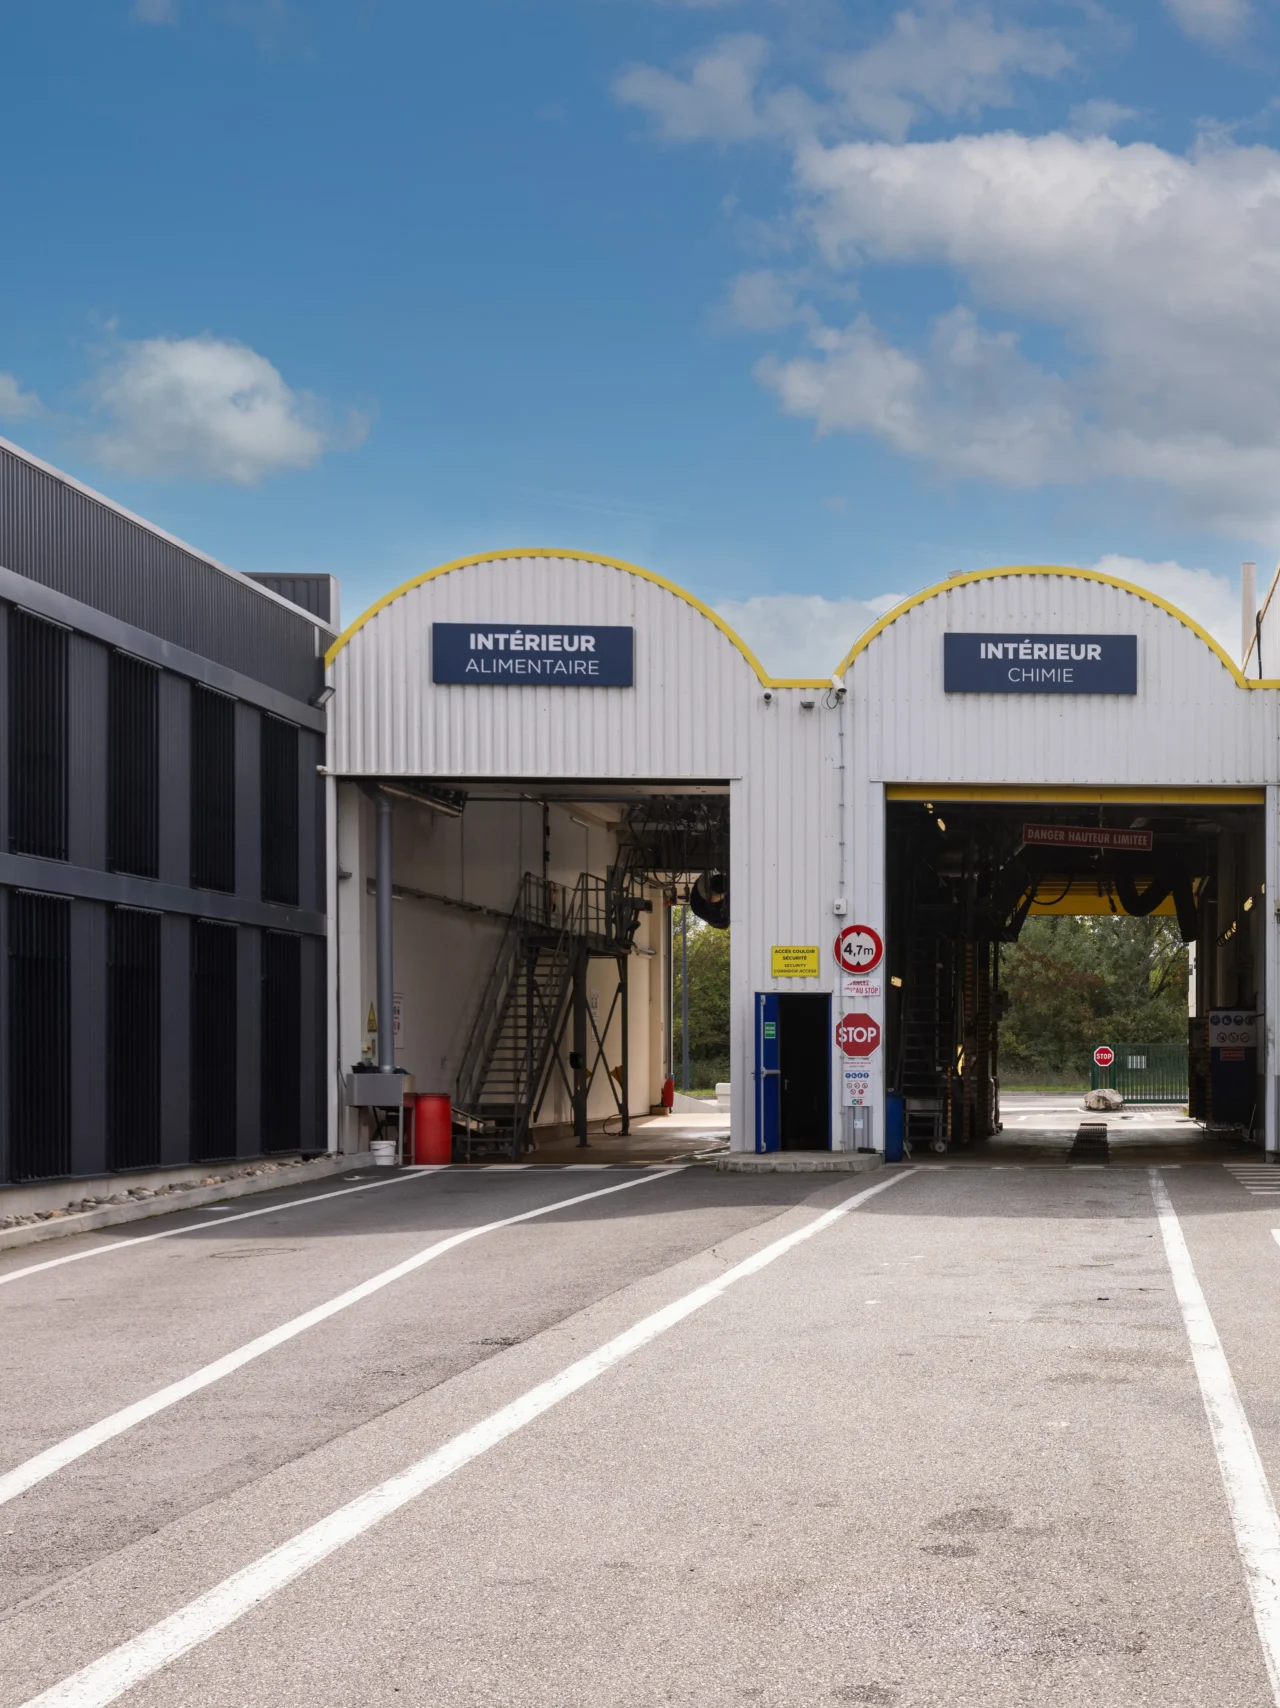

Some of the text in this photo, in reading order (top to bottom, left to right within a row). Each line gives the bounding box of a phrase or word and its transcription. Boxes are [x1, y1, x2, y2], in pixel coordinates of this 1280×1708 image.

[469, 630, 595, 652] INTÉRIEUR
[980, 639, 1101, 660] INTÉRIEUR
[465, 658, 600, 675] ALIMENTAIRE
[1008, 668, 1074, 683] CHIMIE
[1027, 828, 1148, 846] DANGER HAUTEUR LIMITEE
[838, 1027, 877, 1043] STOP
